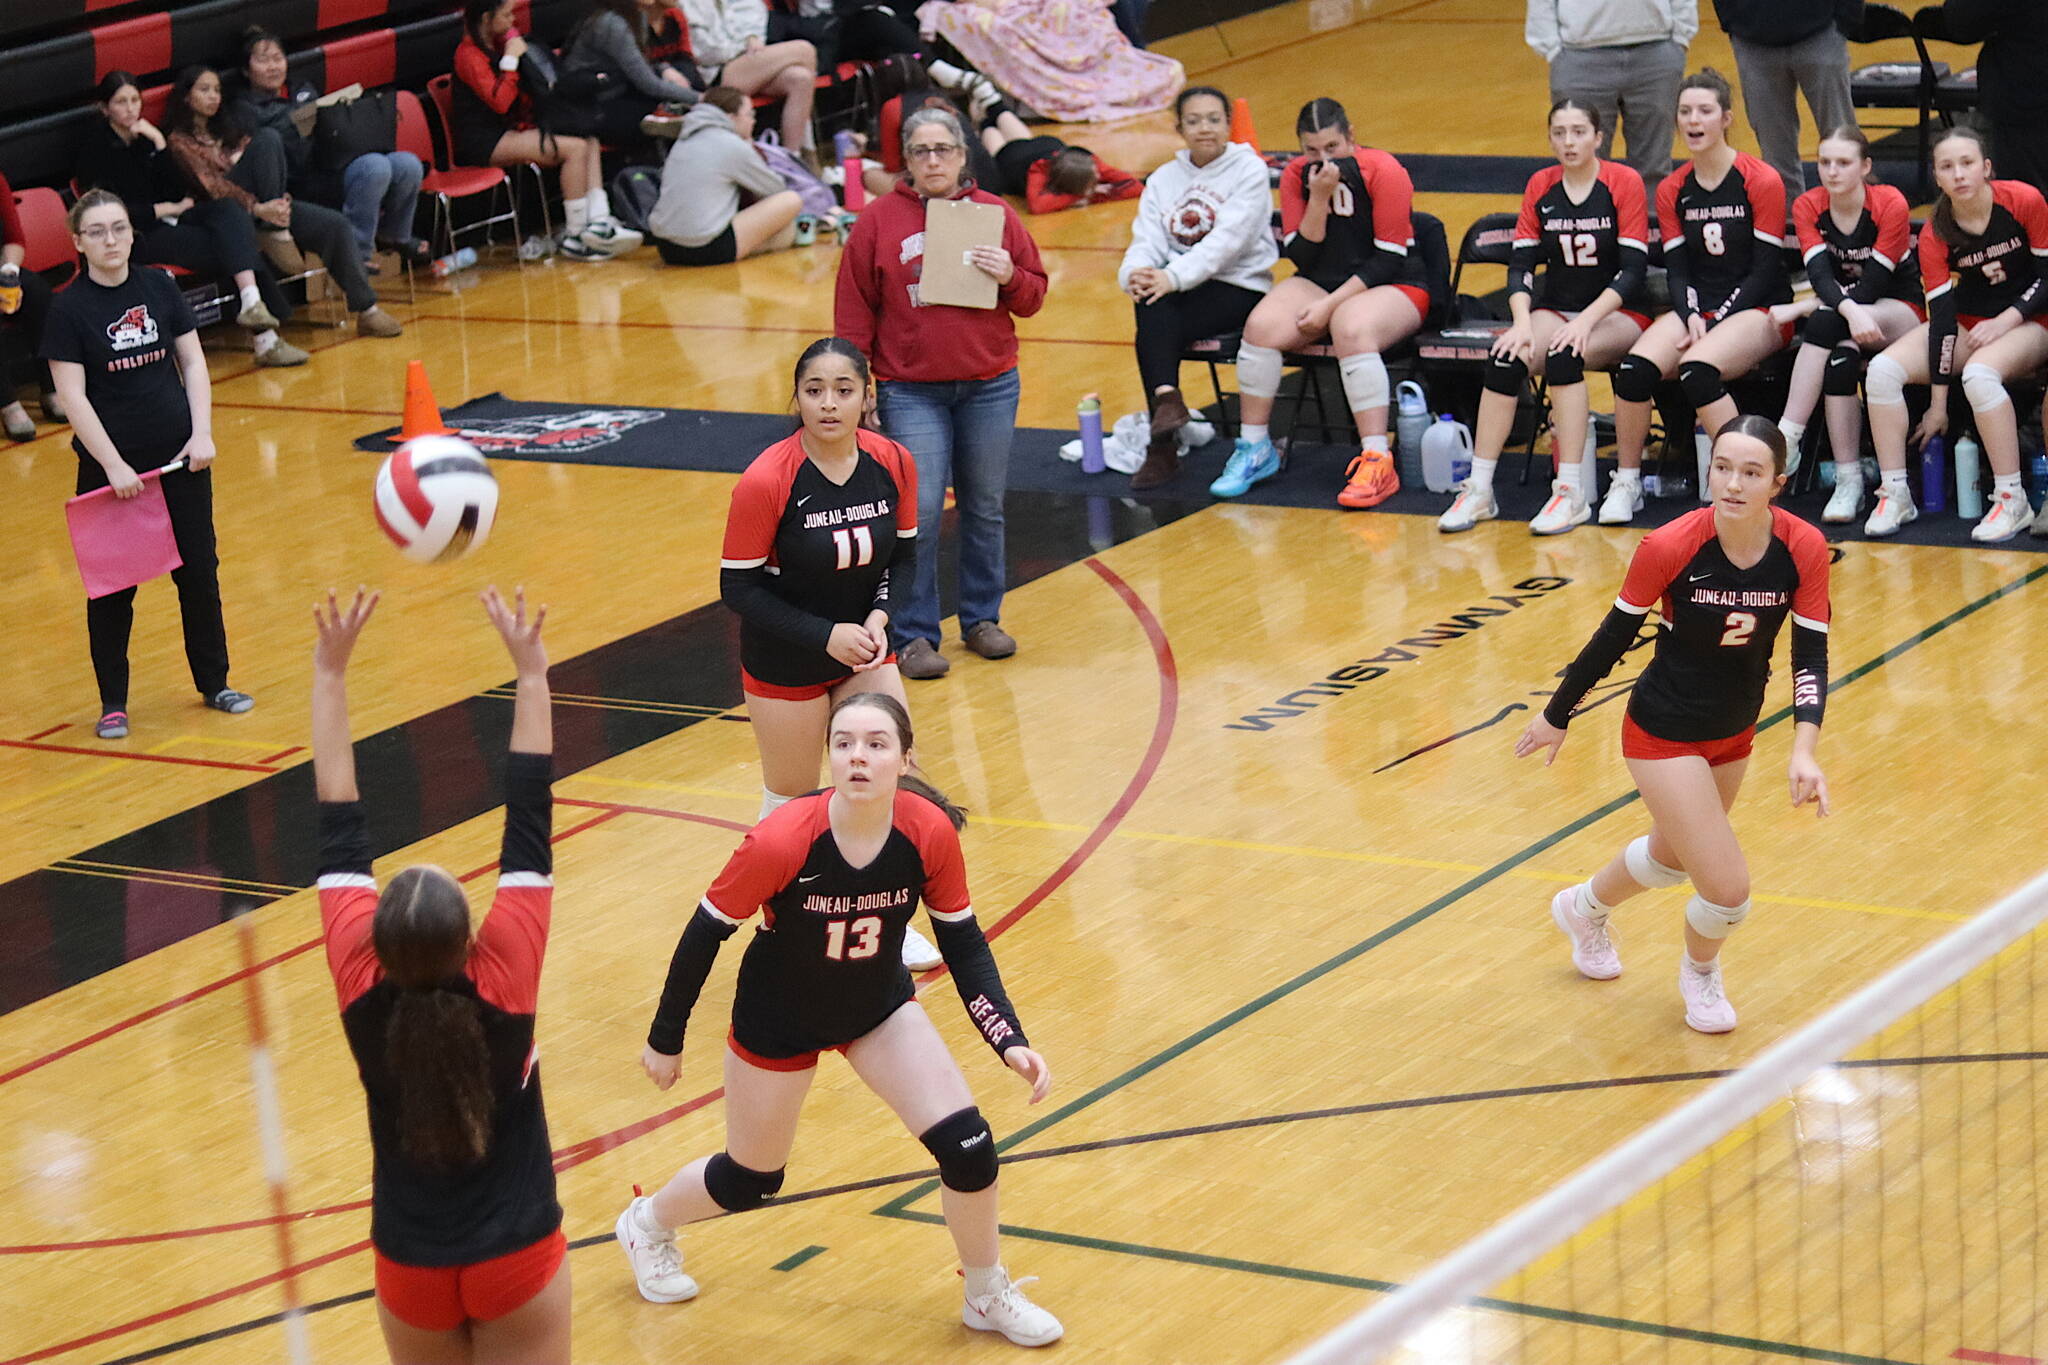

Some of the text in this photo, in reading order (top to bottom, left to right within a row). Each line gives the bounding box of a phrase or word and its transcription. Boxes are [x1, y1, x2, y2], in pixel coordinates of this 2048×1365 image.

[1544, 216, 1611, 231] JUNEAU-DOUGLAS
[1684, 205, 1745, 221] JUNEAU-DOUGLAS
[1558, 233, 1599, 267] 12
[1702, 222, 1726, 256] 8
[1981, 260, 2007, 286] 5
[803, 499, 890, 529] JUNEAU-DOUGLAS
[832, 525, 873, 570] 11
[1720, 611, 1757, 646] 2
[1222, 576, 1574, 732] GYMNASIUM
[1795, 668, 1818, 707] ARS
[803, 887, 909, 914] JUNEAU-DOUGLAS
[825, 915, 883, 960] 13
[969, 994, 1014, 1045] BEARS
